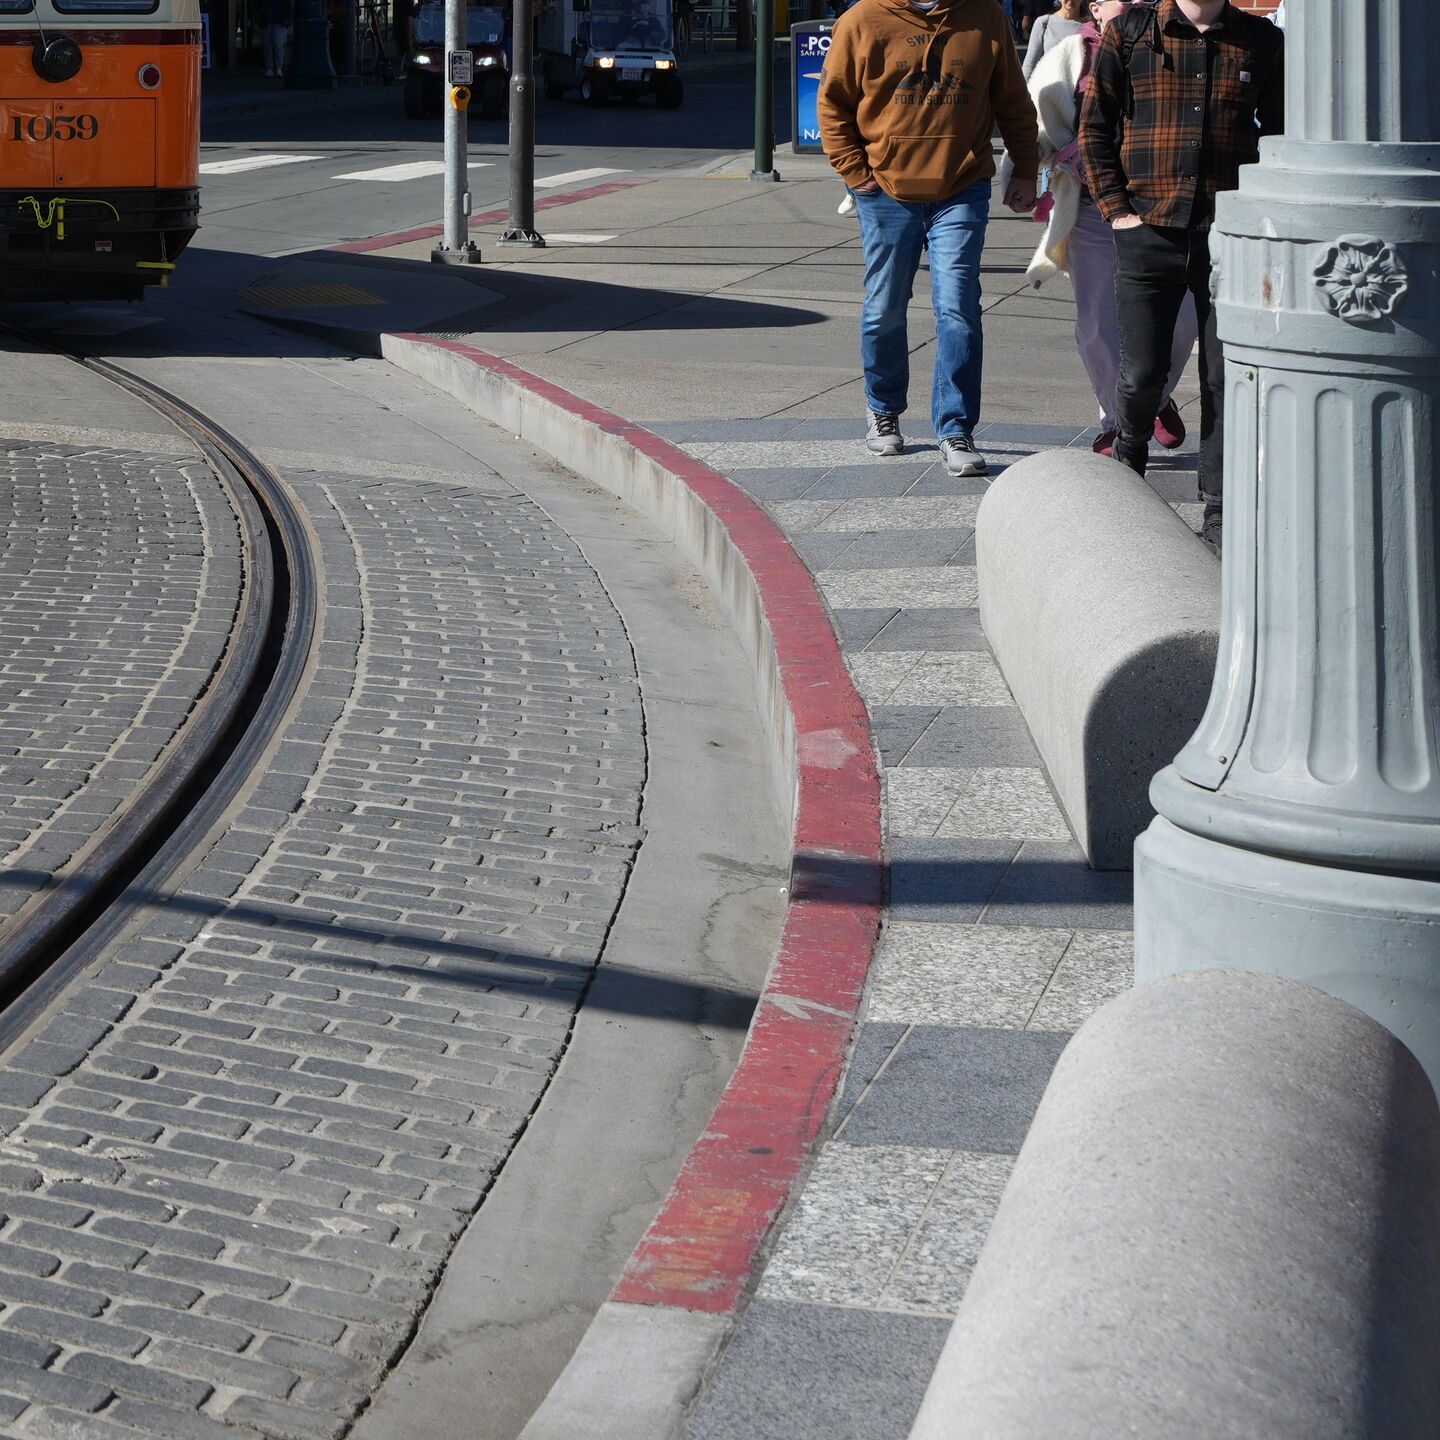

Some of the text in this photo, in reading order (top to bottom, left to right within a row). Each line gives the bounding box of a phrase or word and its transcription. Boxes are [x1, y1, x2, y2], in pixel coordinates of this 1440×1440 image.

[895, 94, 914, 104] FOR
[926, 94, 969, 105] SOLDIER
[8, 115, 98, 141] 1059
